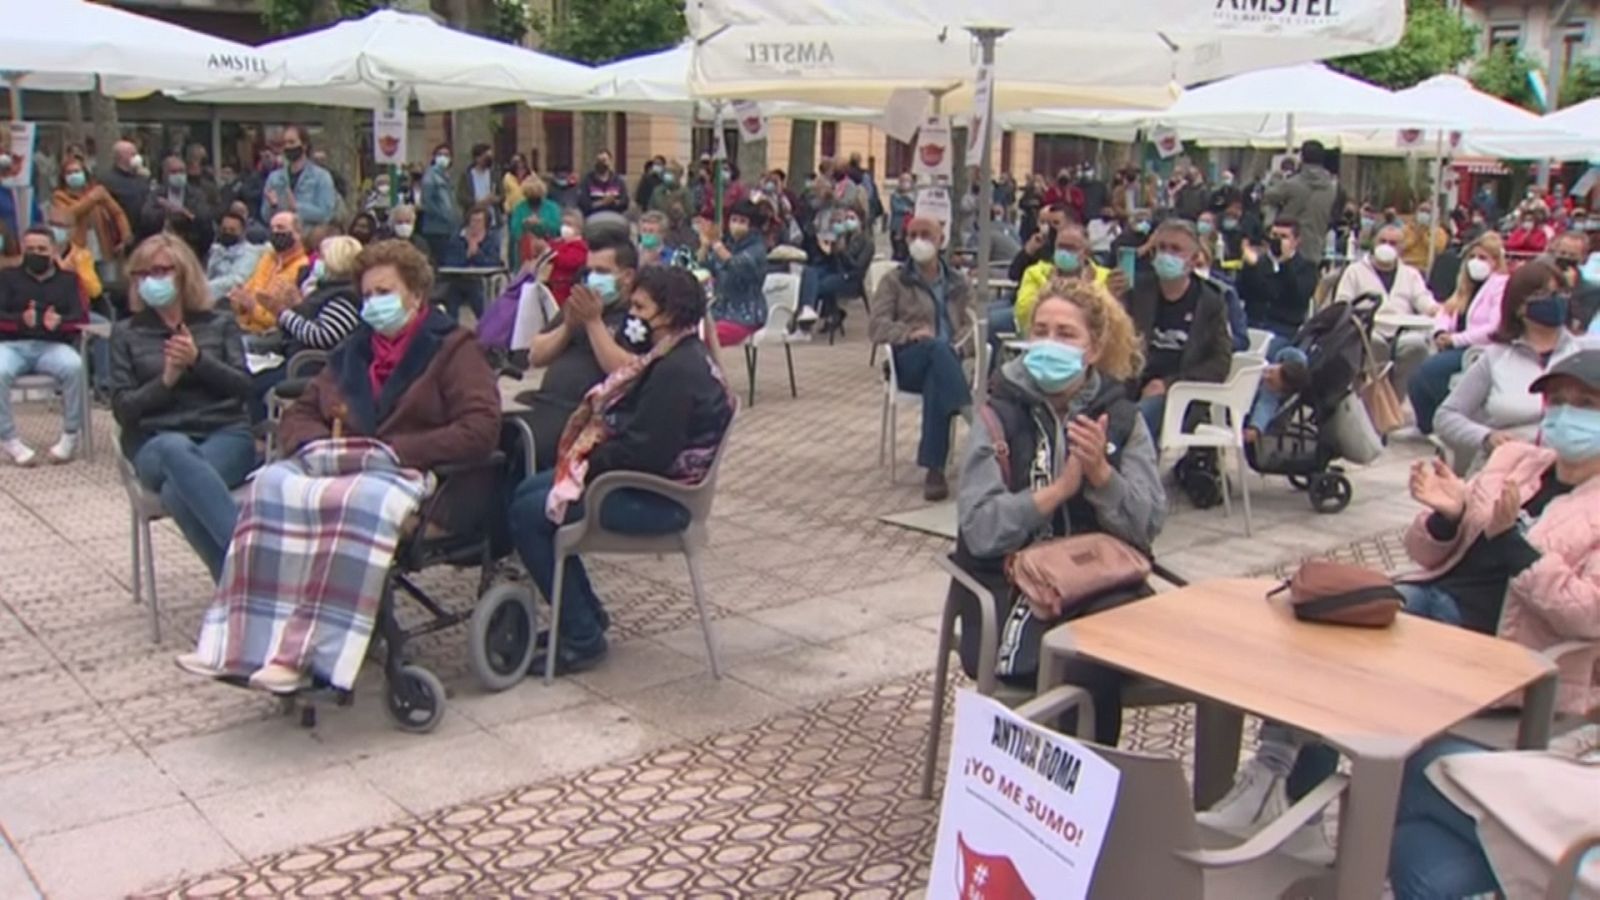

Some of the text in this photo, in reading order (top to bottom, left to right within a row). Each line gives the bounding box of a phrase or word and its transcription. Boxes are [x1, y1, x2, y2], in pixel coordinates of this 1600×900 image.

[1038, 742, 1082, 795] ROMA
[998, 774, 1023, 803] ME
[1025, 794, 1084, 847] SUMO!
